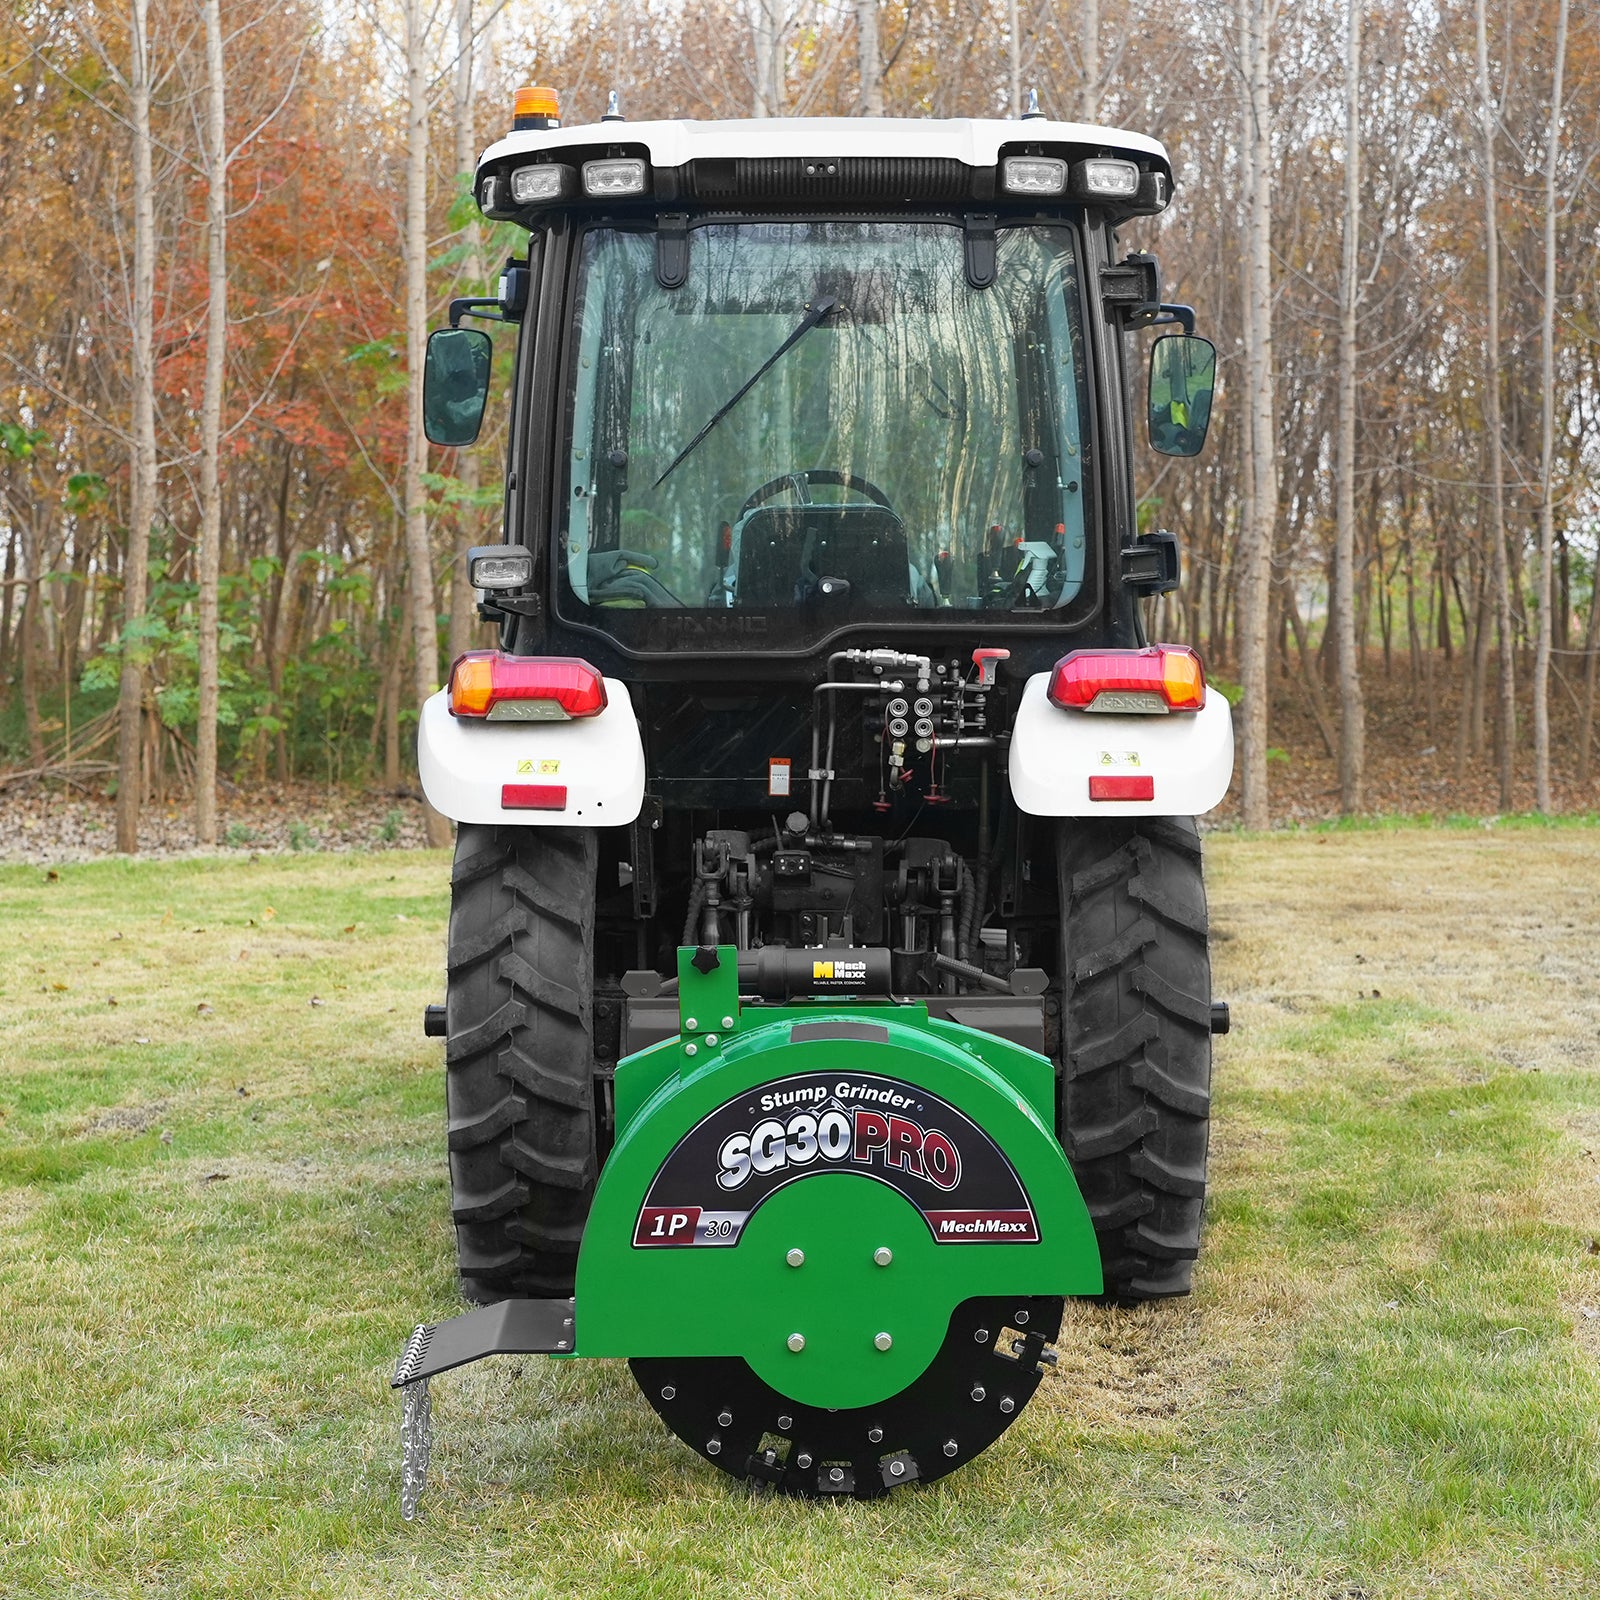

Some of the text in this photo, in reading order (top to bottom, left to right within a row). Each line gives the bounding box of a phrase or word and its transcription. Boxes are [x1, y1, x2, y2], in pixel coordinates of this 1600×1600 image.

[834, 961, 866, 970] Mech
[834, 969, 866, 978] Maxx
[760, 1082, 915, 1112] Stump Grinder
[650, 1213, 732, 1238] 1P 30
[940, 1219, 1028, 1233] MechMaxx
